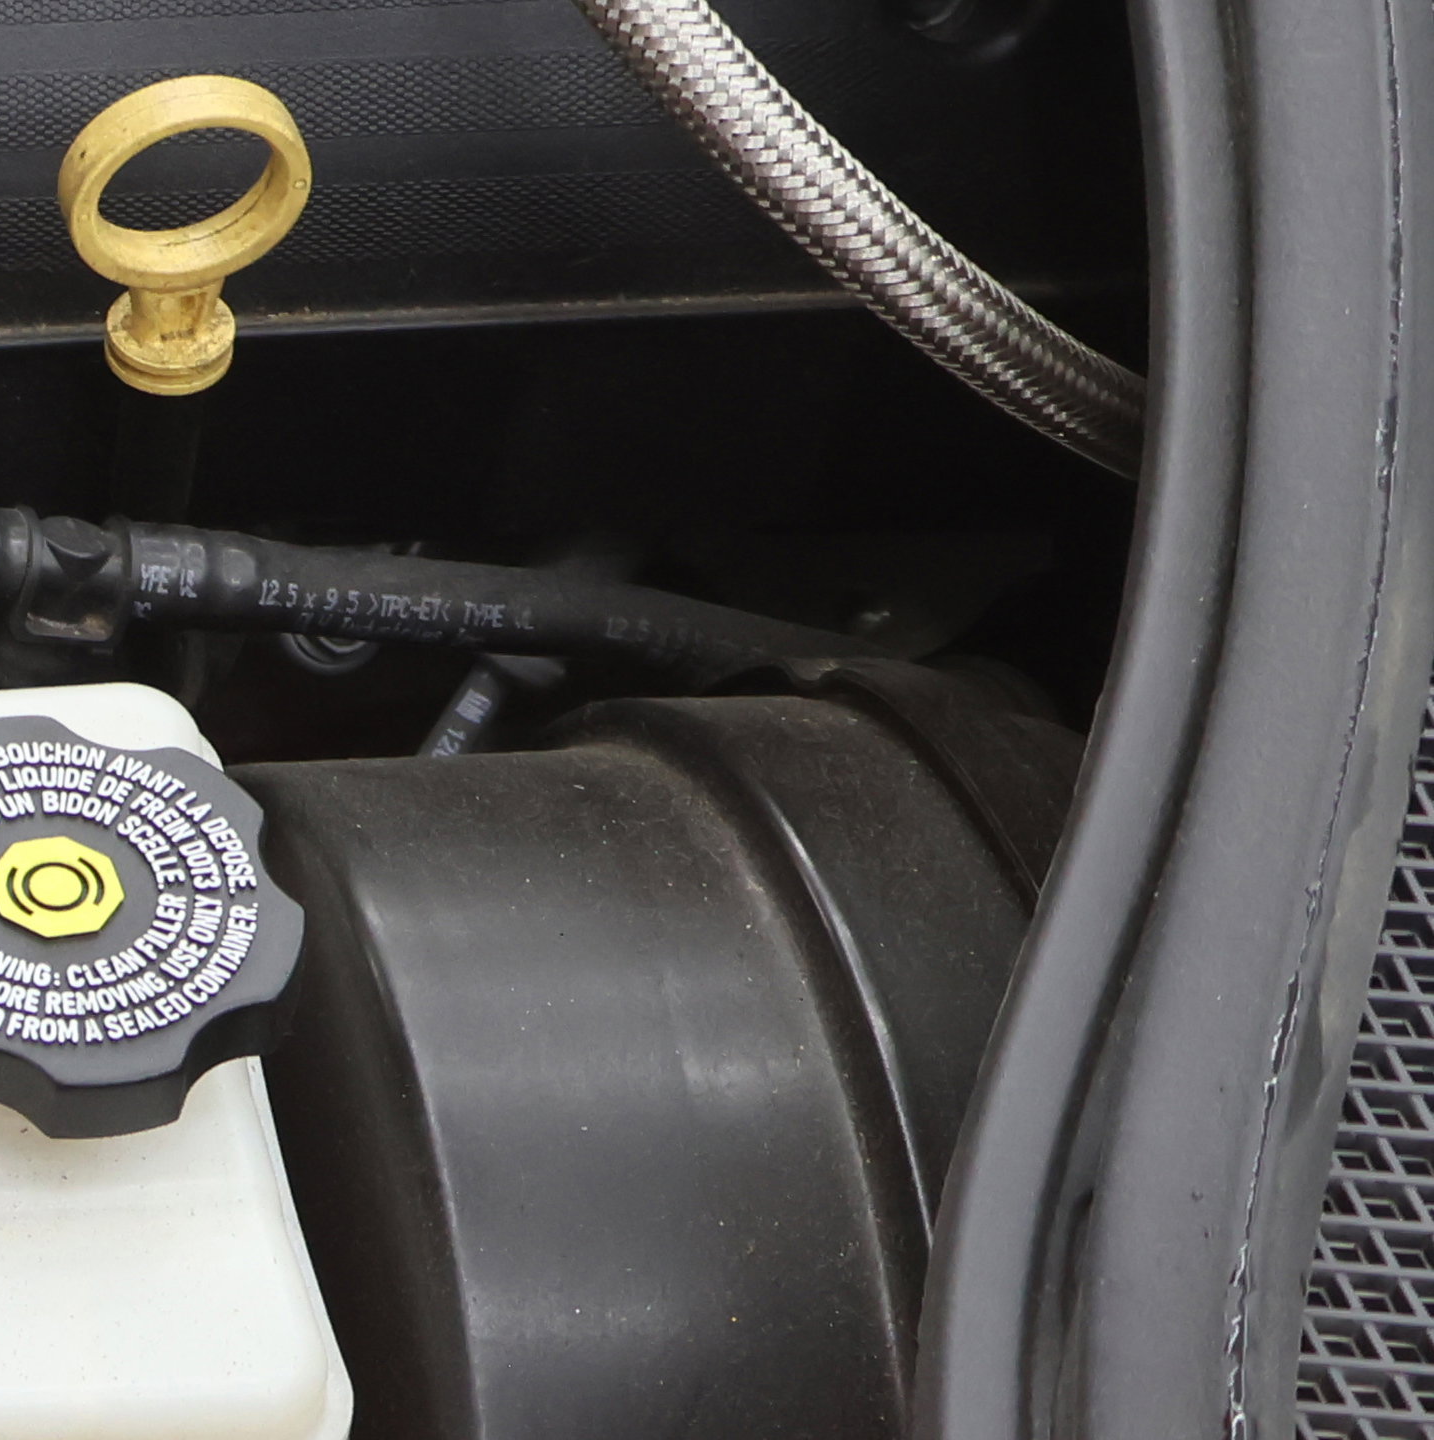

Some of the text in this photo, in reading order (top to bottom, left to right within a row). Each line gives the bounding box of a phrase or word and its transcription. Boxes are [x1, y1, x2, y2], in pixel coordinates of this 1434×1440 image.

[41, 790, 120, 826] BIDON
[116, 813, 186, 891] SCELLE.
[97, 774, 133, 803] DE
[130, 791, 196, 844] FREIN
[178, 836, 222, 891] DOT3
[106, 754, 186, 799] AVANT
[175, 791, 212, 822] LA
[200, 817, 258, 895] DEPOSE.
[5, 1013, 80, 1045] FROM
[85, 1018, 103, 1044] A
[103, 991, 193, 1042] SEALED
[181, 901, 259, 1005] CONTAINER.
[44, 970, 175, 1016] REMOVING.
[159, 938, 207, 981] USE
[187, 893, 223, 945] ONLY
[66, 947, 147, 988] CLEAN
[134, 892, 187, 961] FILLER
